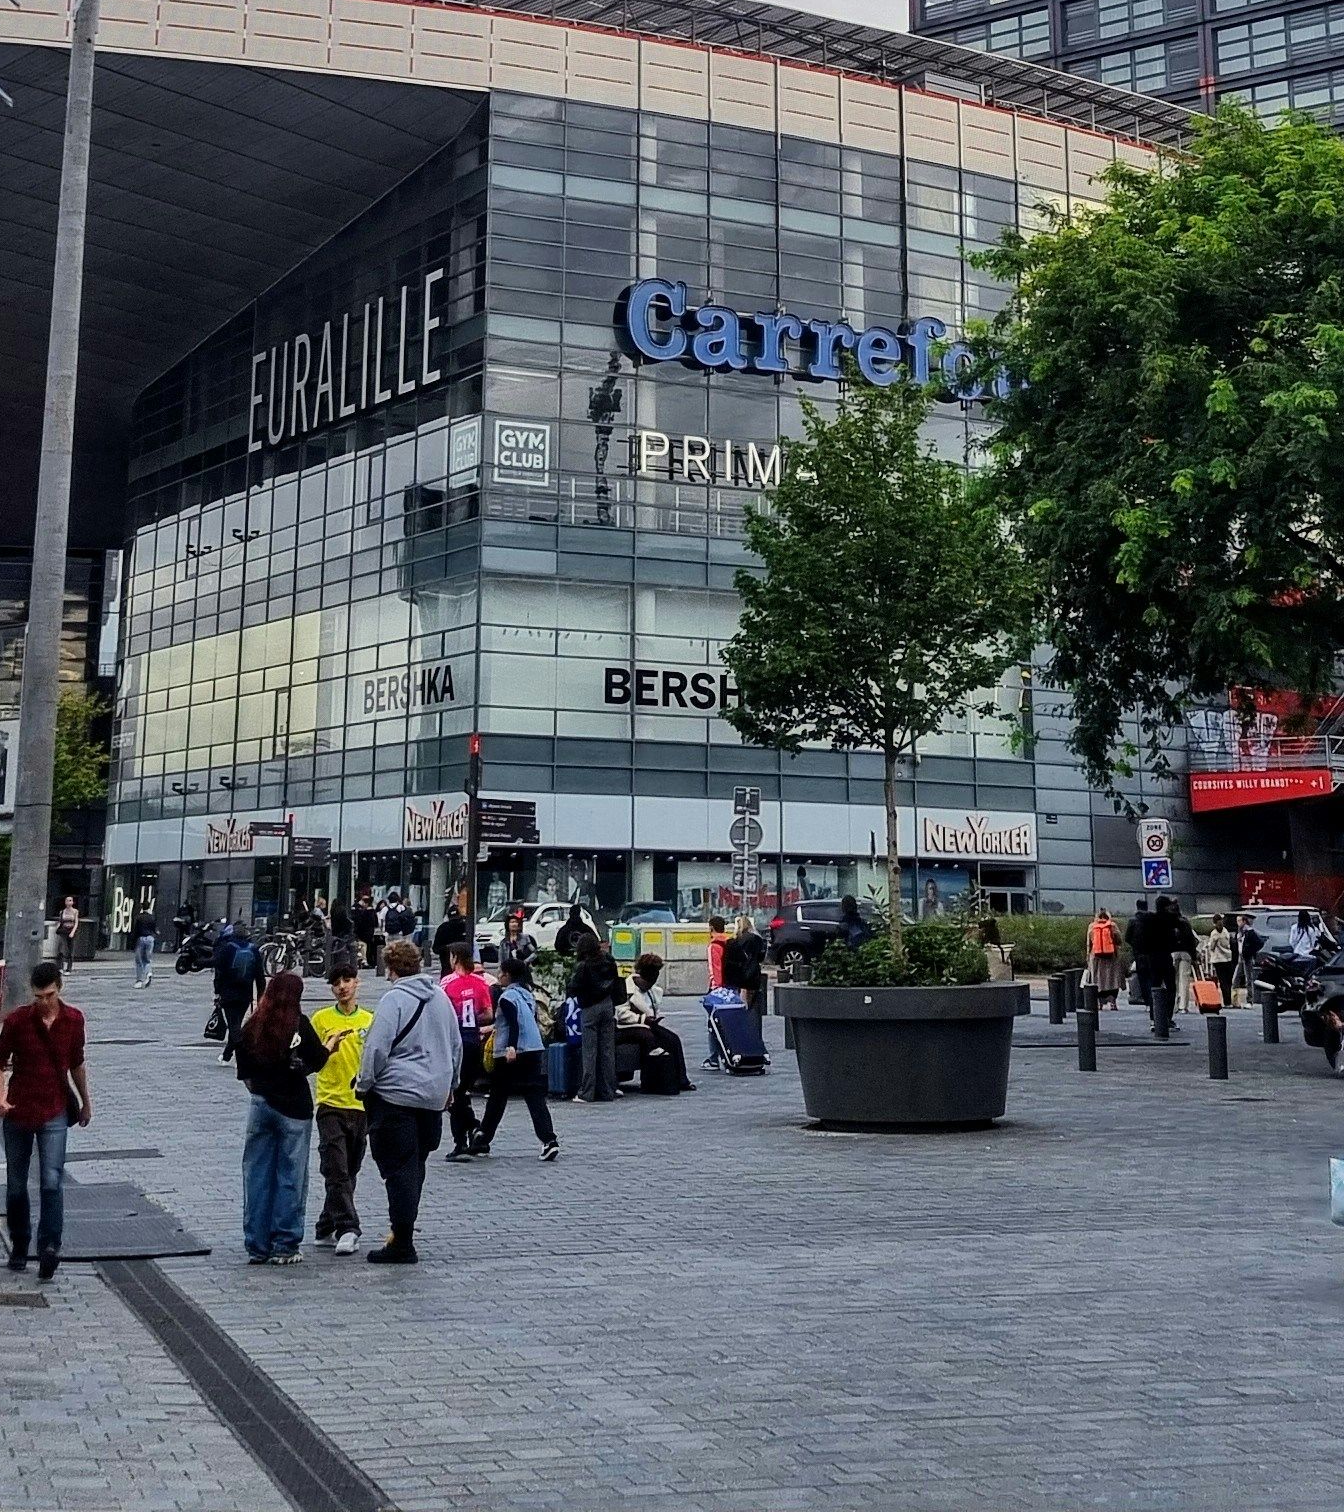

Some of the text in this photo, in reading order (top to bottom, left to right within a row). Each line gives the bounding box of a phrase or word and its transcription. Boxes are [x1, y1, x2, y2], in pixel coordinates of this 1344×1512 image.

[248, 268, 443, 453] EURALILLE
[627, 278, 1030, 401] Carrefo
[500, 450, 544, 469] CLUB
[364, 664, 455, 714] BERSHKA
